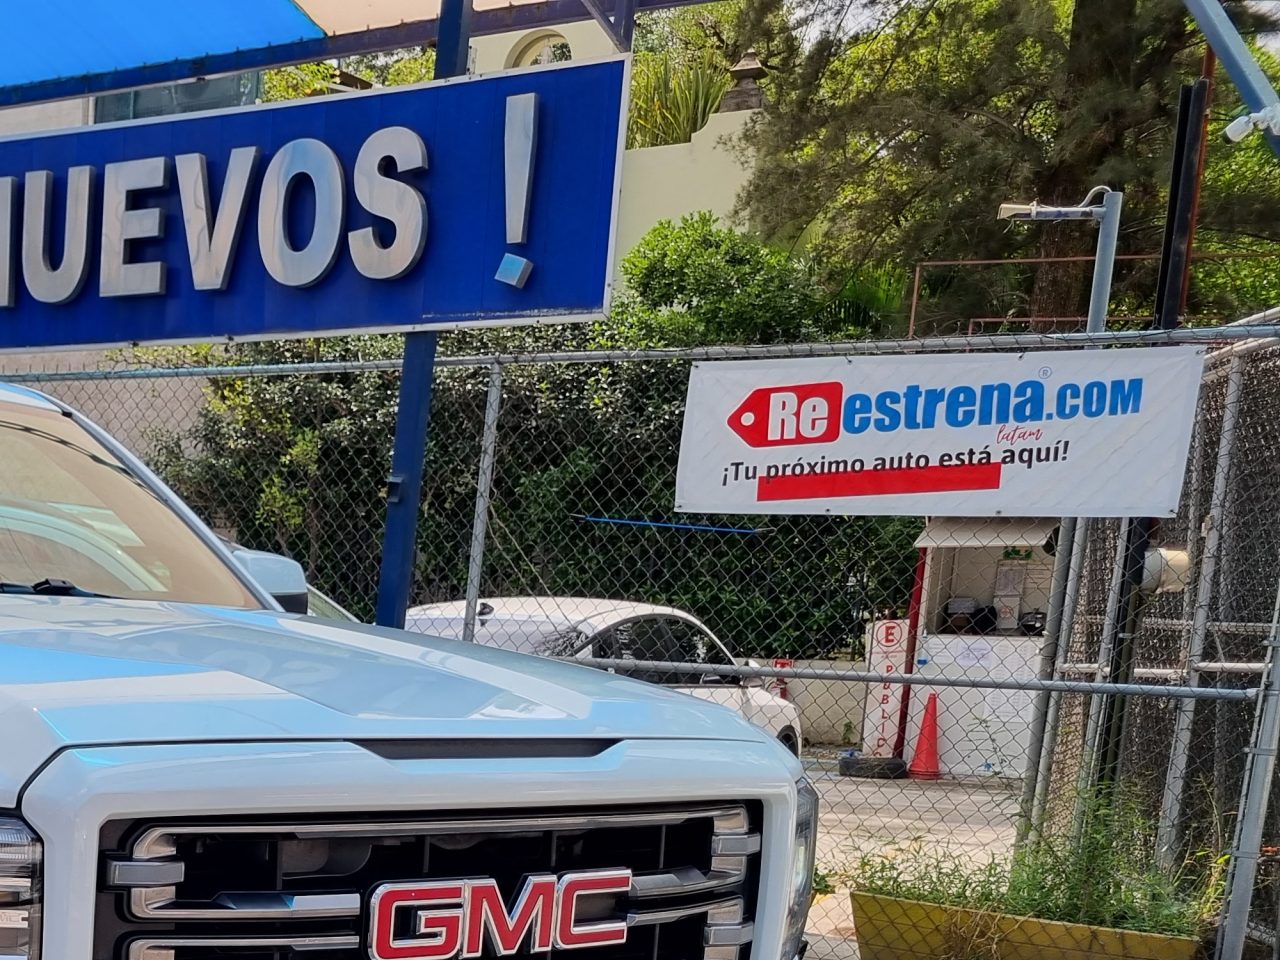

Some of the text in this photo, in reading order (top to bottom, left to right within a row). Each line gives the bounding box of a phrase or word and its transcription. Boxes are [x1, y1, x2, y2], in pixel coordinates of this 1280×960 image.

[996, 424, 1043, 446] latam
[722, 440, 1070, 487] ¡Tu próximo auto está aquí!
[884, 625, 896, 644] E
